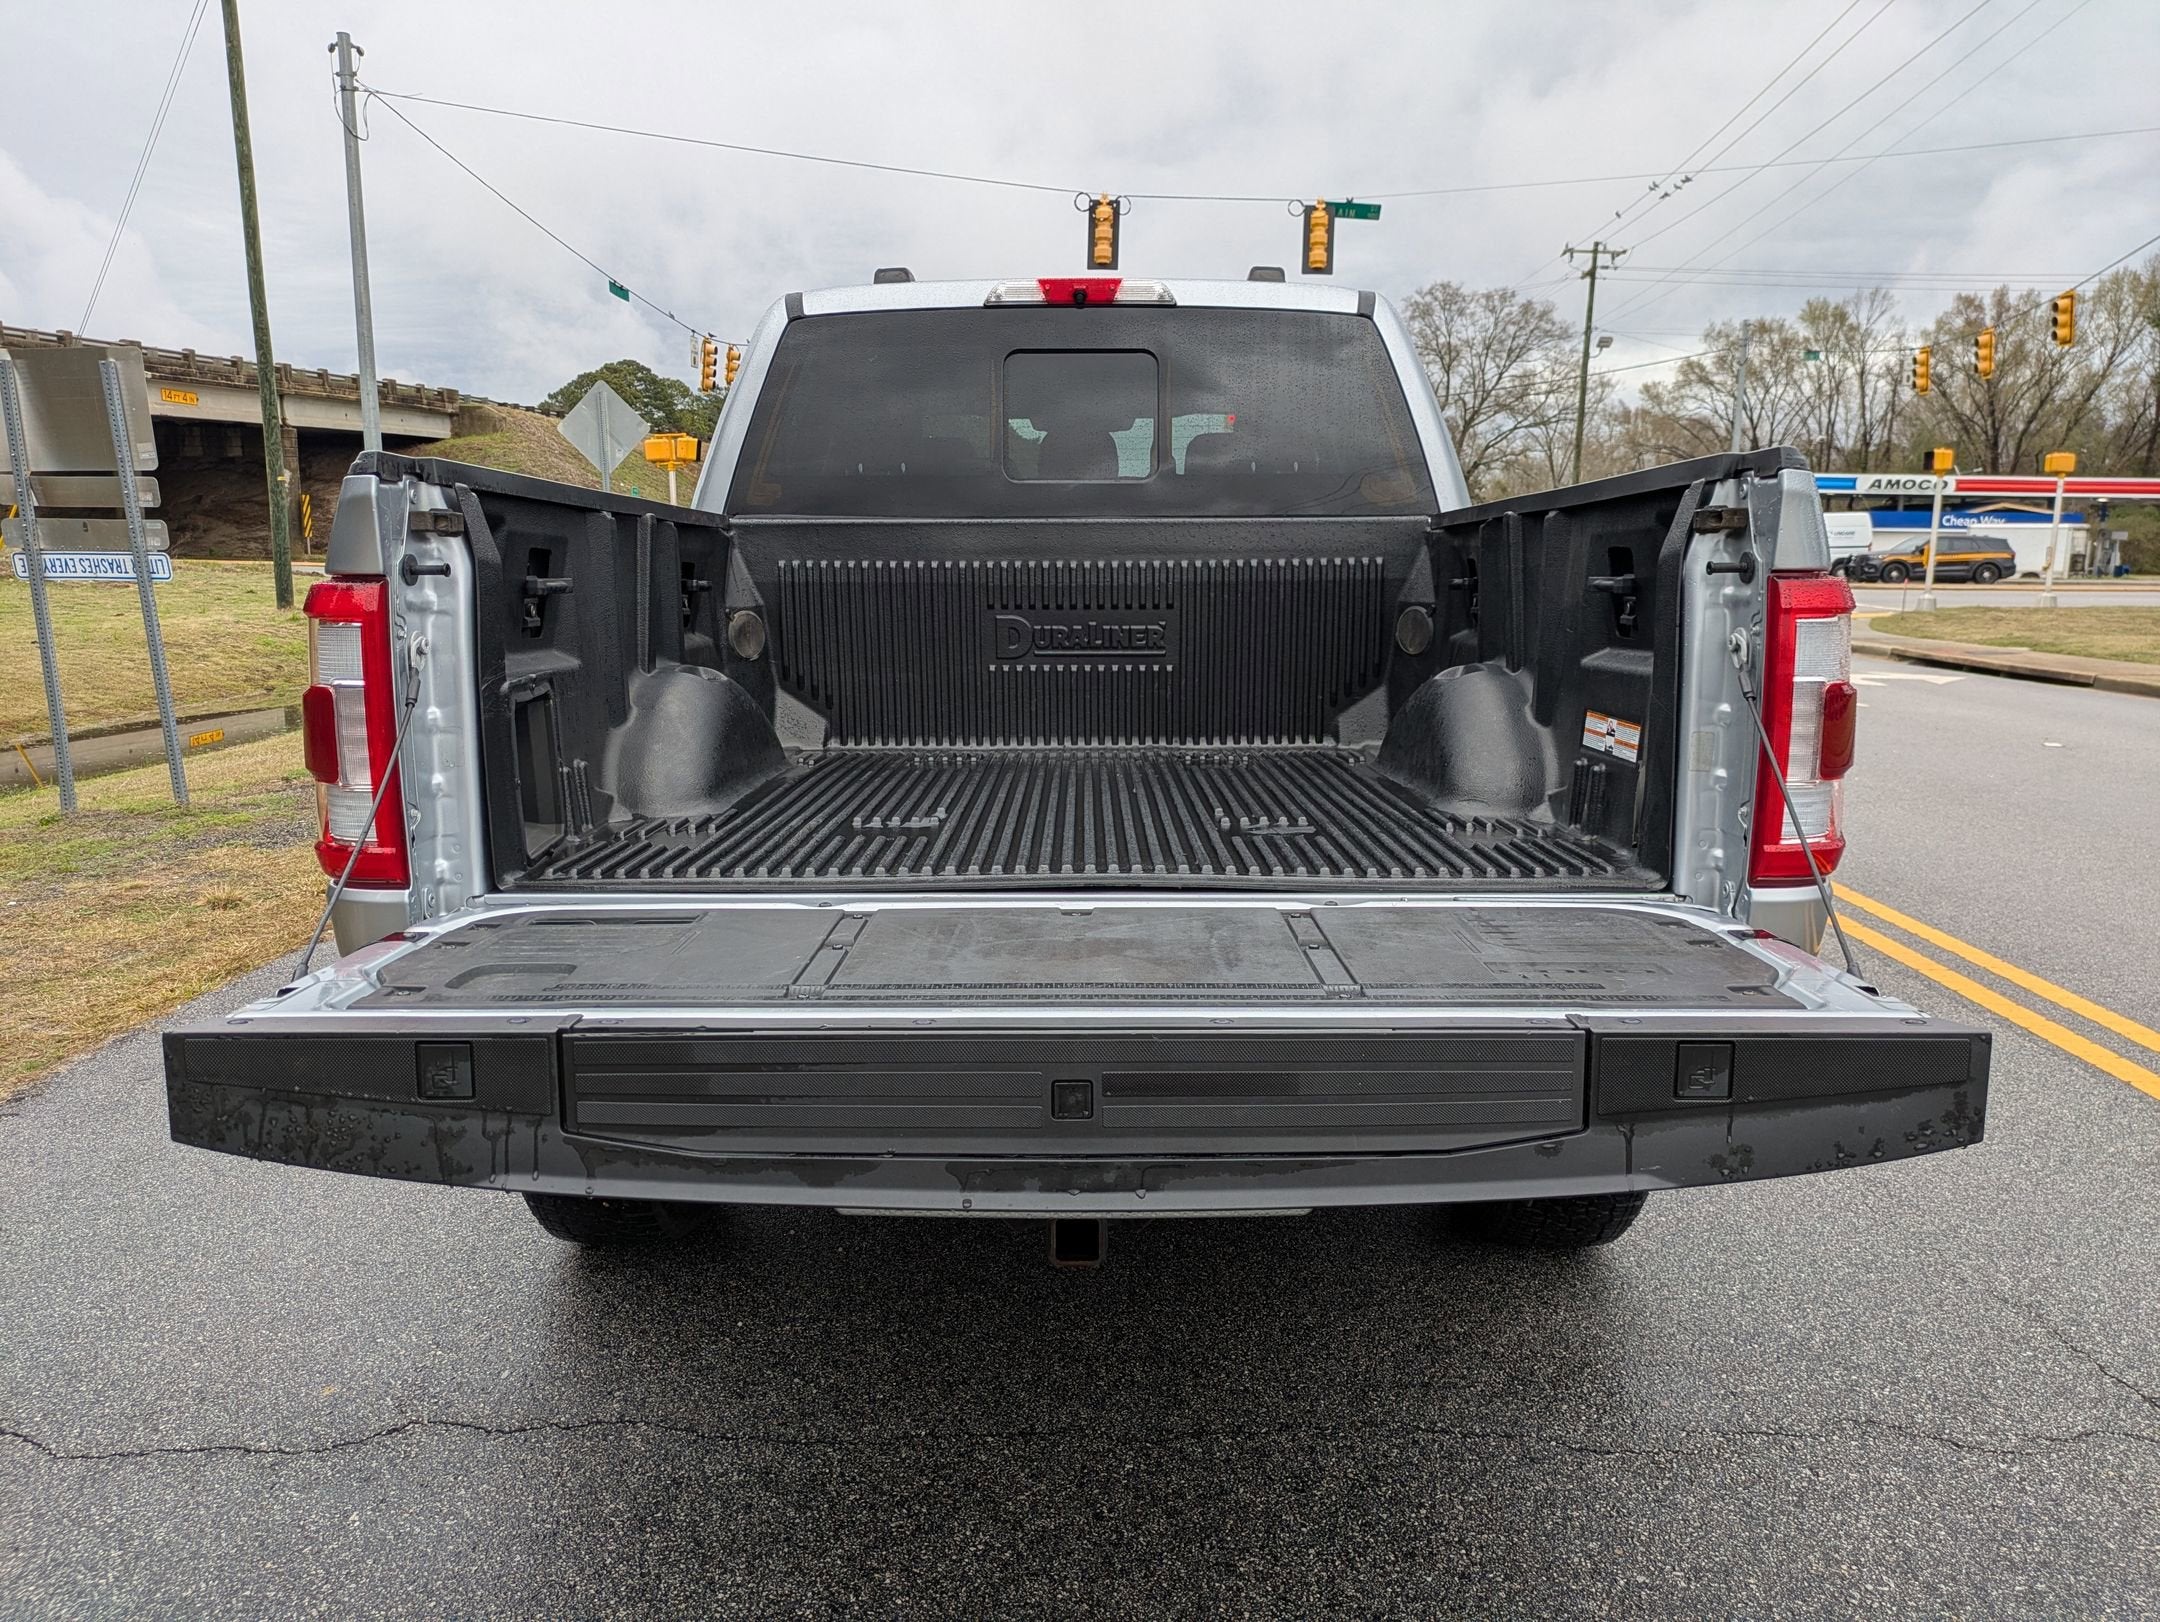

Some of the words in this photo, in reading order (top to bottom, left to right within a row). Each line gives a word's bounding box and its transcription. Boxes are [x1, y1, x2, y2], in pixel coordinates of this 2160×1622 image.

[1337, 208, 1356, 218] AIN
[163, 390, 172, 400] 14
[183, 393, 188, 402] 4
[1868, 479, 1948, 491] AMOCO
[1942, 514, 1978, 526] Cheap
[1980, 515, 2006, 525] Way
[18, 557, 77, 573] EVERYE
[79, 558, 129, 574] TRASHES
[130, 558, 165, 574] LITR
